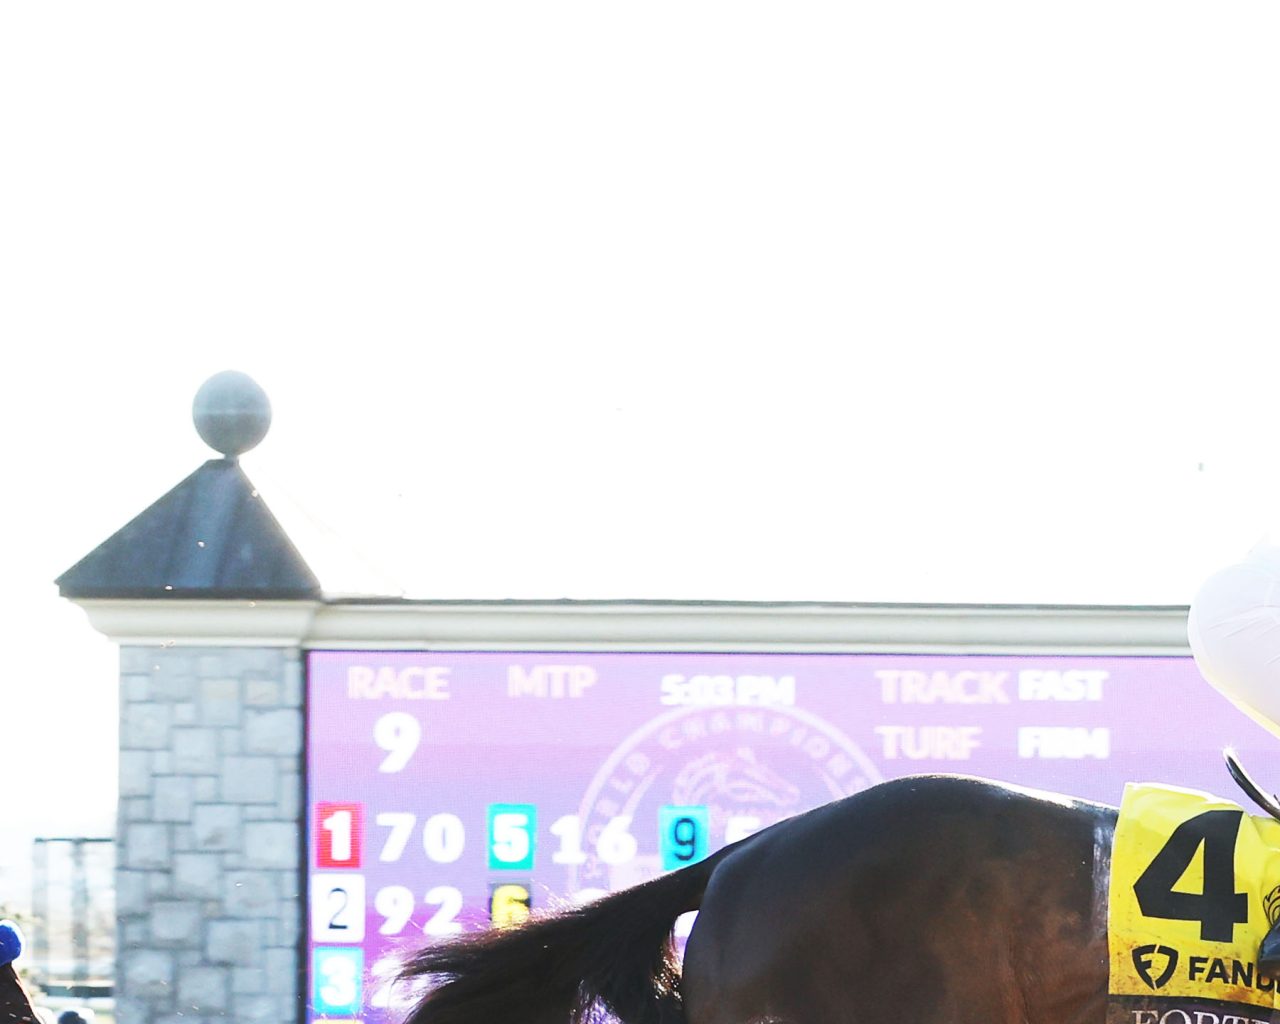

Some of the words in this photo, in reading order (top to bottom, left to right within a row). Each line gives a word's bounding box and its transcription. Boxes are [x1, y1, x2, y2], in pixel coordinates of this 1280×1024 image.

[347, 666, 451, 700] RACE
[507, 664, 598, 698] MTP
[736, 675, 796, 705] PM
[874, 670, 1010, 704] TRACK
[1018, 670, 1110, 702] FAST
[373, 711, 421, 774] 9
[874, 726, 983, 759] TURF
[322, 810, 353, 861] 1
[492, 813, 530, 863] 5
[673, 817, 697, 861] 9
[1133, 810, 1248, 943] 4
[328, 887, 349, 930] 2
[320, 955, 357, 1007] 3
